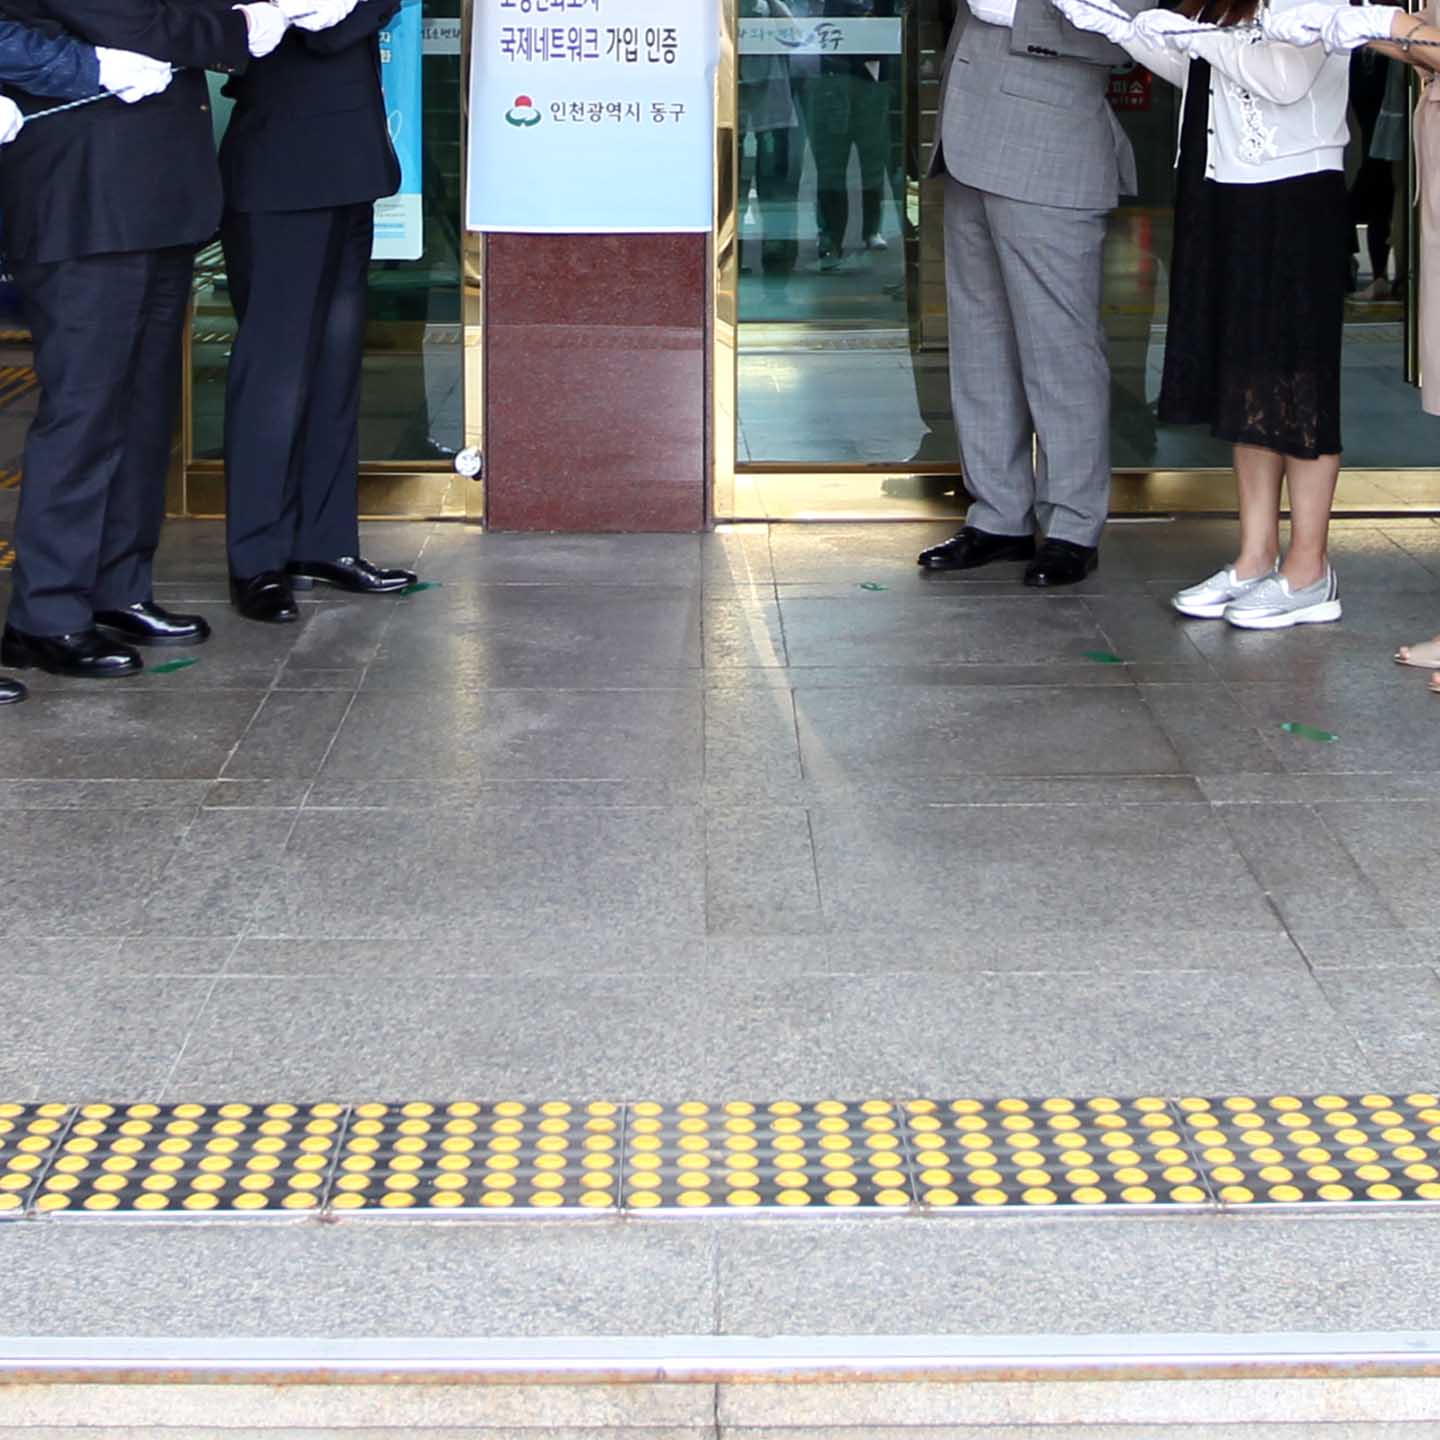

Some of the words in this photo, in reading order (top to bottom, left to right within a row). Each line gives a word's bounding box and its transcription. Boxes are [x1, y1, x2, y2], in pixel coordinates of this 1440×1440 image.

[500, 28, 599, 62] 국제네트워크
[606, 28, 638, 63] 가입
[644, 28, 678, 64] 인증
[550, 101, 641, 124] 인천광역시
[650, 103, 685, 124] 동구
